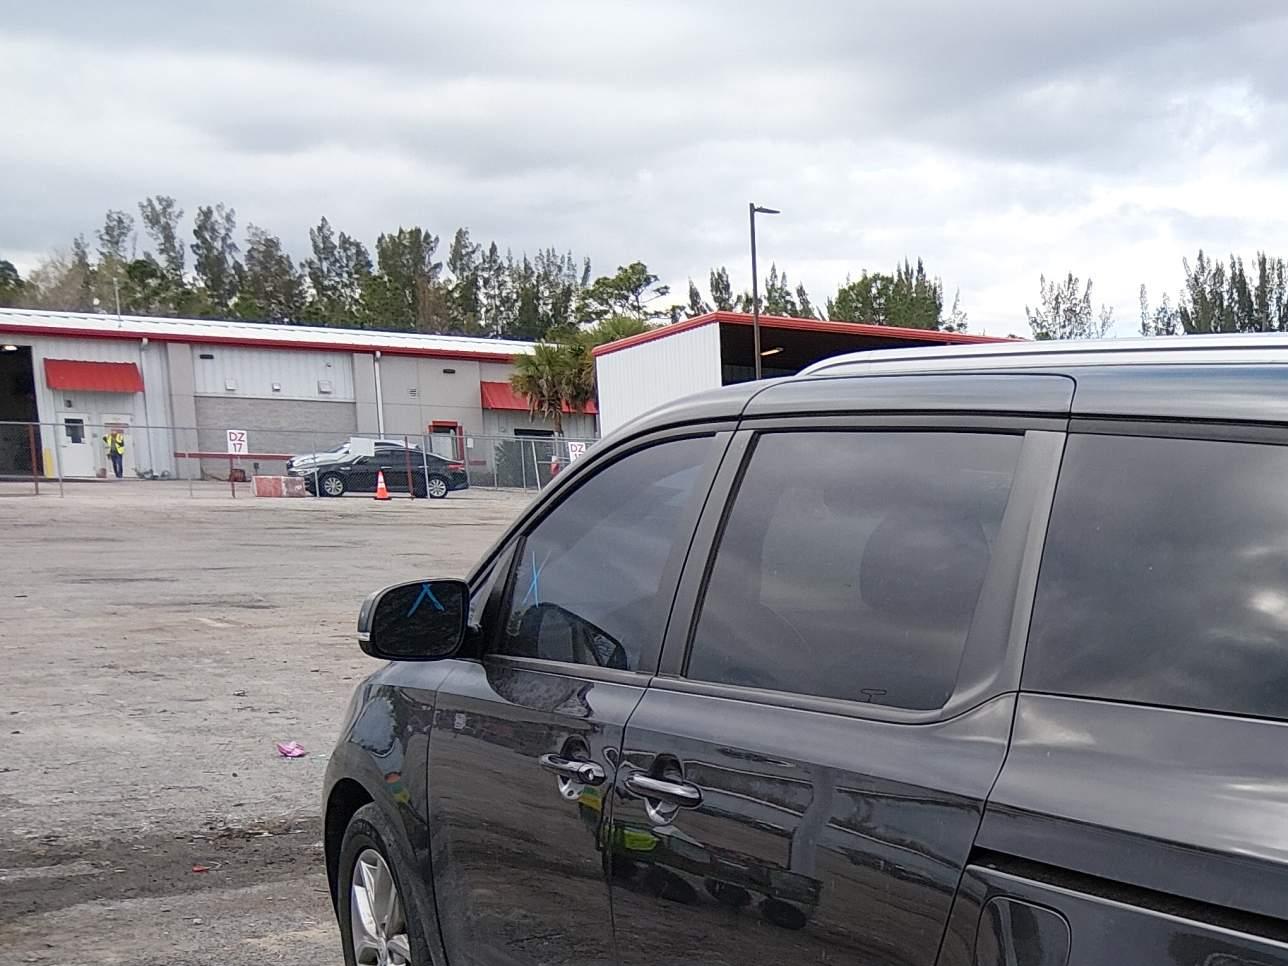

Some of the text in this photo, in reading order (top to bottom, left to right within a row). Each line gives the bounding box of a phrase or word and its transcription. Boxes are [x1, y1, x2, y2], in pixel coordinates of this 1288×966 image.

[228, 431, 246, 443] DZ
[232, 442, 243, 453] 17
[570, 443, 585, 454] DZ
